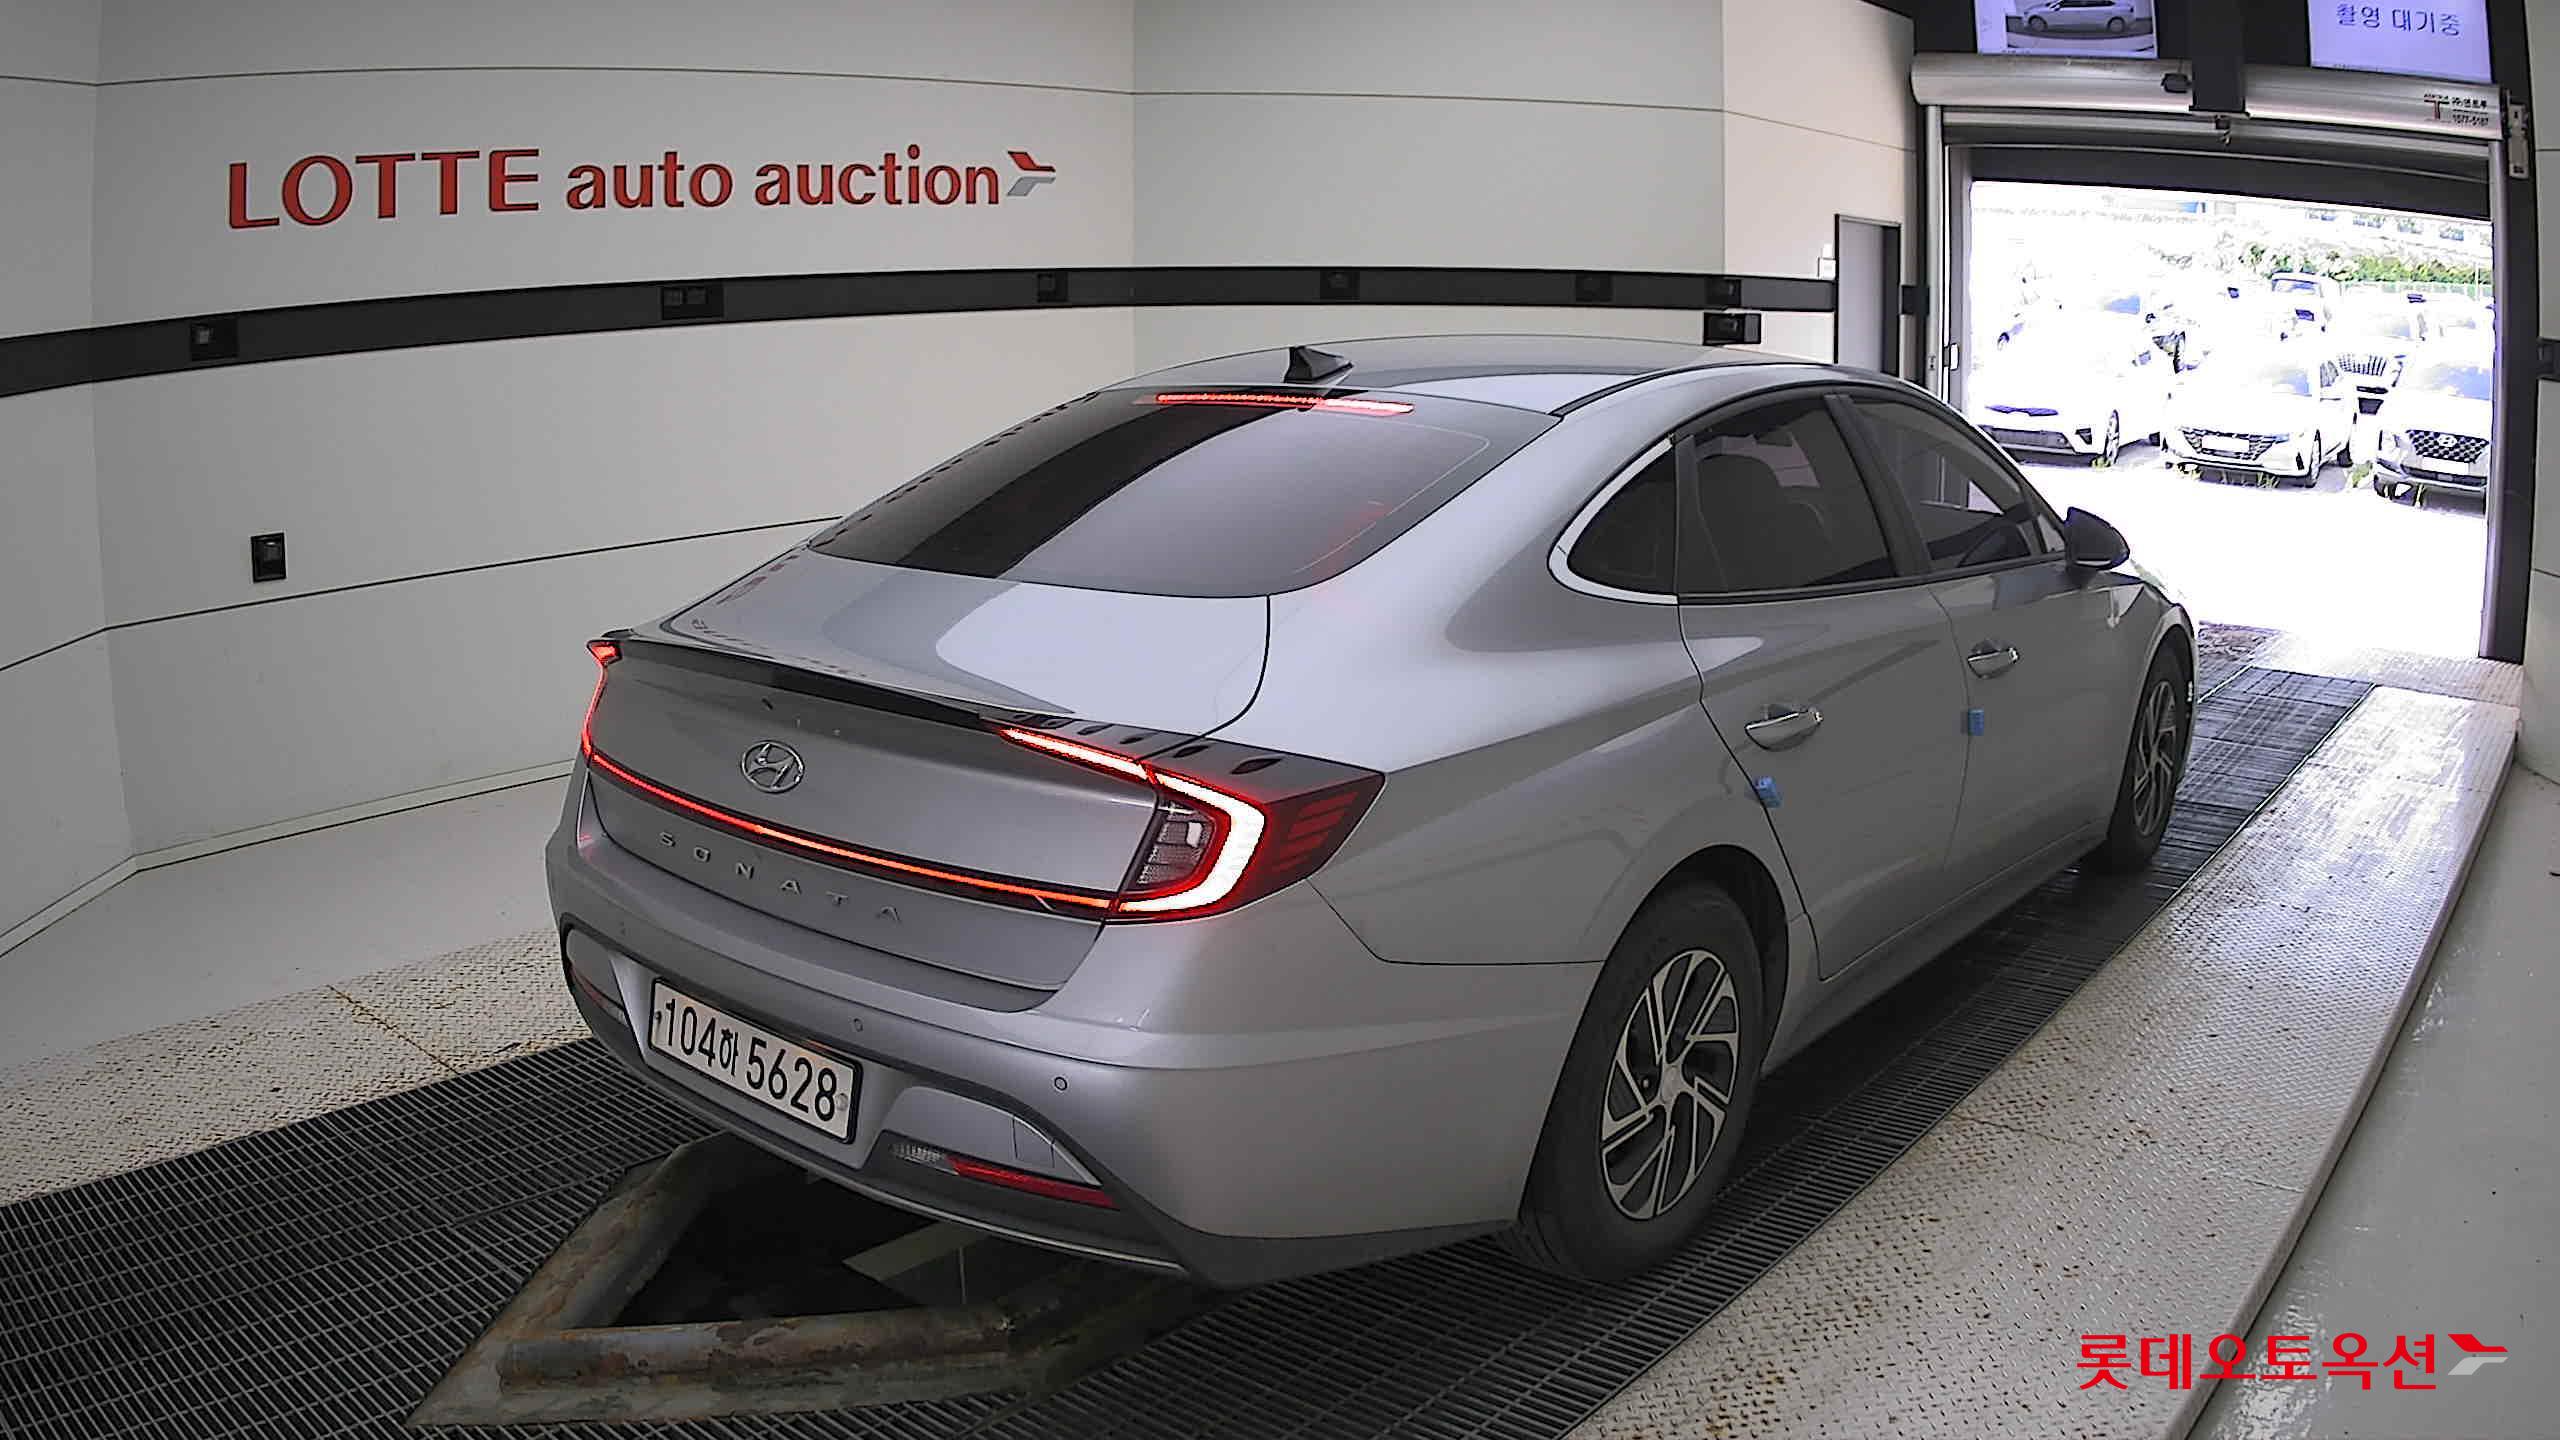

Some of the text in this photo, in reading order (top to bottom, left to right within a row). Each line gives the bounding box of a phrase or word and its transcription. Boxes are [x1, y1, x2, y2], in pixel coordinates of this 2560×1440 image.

[2337, 4, 2461, 37] 촬영 대기중
[228, 143, 1002, 232] LOTTE auto auction
[659, 831, 901, 921] SONATA
[746, 1037, 837, 1122] 5628
